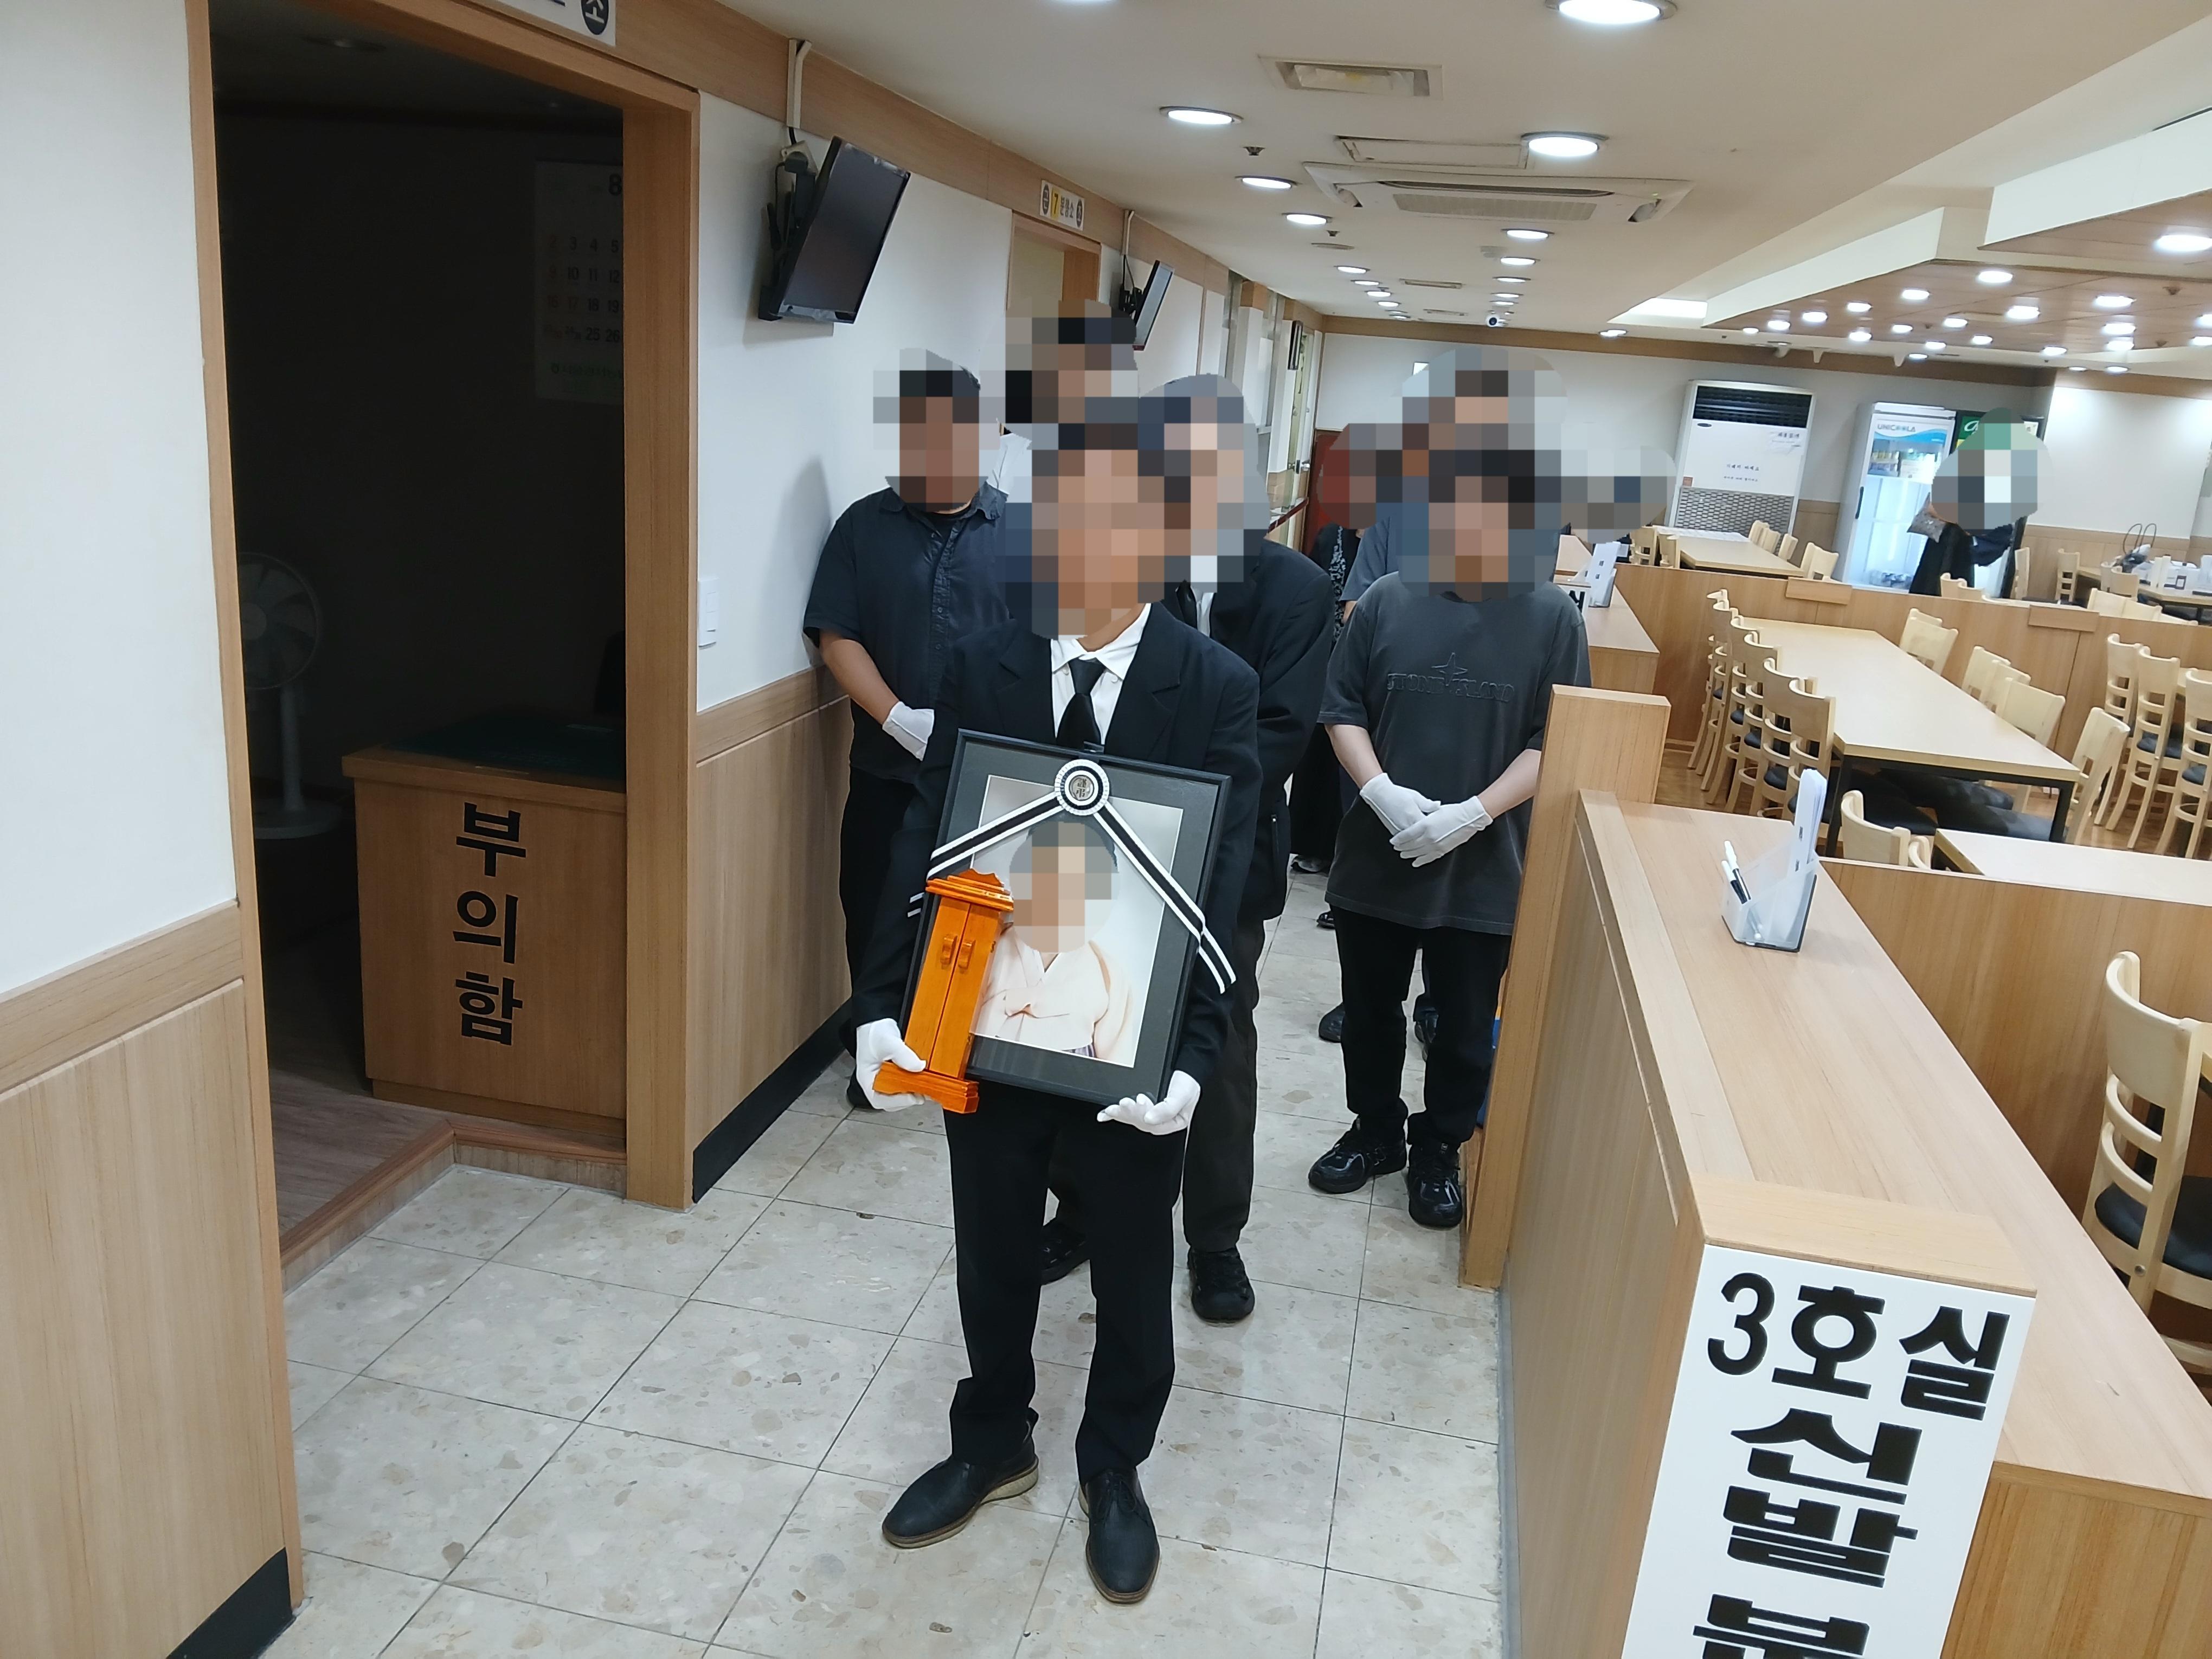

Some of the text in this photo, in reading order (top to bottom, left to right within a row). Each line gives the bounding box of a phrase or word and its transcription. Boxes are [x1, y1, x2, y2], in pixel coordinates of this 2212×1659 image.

[608, 173, 622, 196] 8
[1054, 193, 1059, 215] 7
[569, 236, 577, 251] 3
[589, 238, 597, 252] 4
[610, 240, 619, 253] 5
[567, 266, 579, 281] 10
[608, 269, 620, 284] 12
[587, 298, 599, 312] 18
[608, 299, 619, 313] 19
[586, 327, 600, 341] 25
[605, 329, 620, 343] 26
[453, 802, 526, 1046] 부의함
[1707, 1271, 2011, 1422] 3호실
